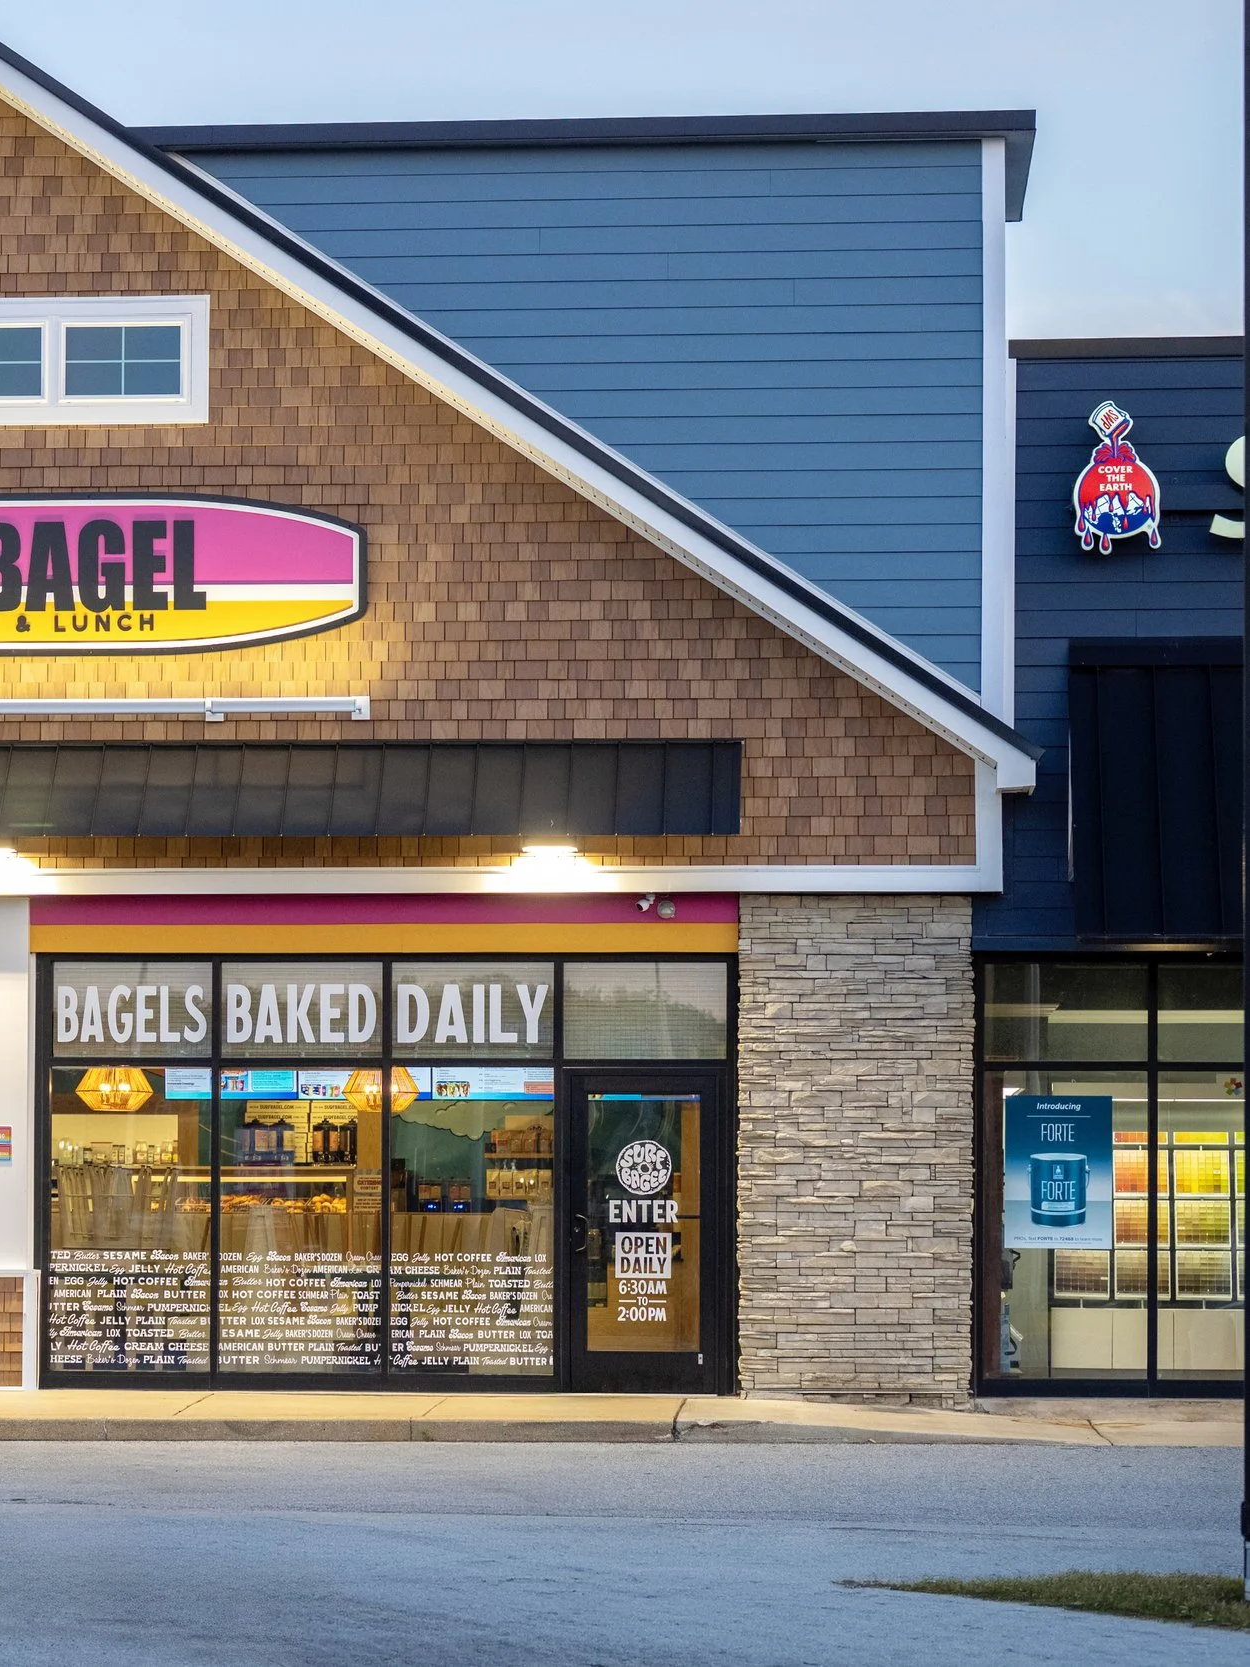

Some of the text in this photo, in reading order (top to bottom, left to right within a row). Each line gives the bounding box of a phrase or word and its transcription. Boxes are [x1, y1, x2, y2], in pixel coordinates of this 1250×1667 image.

[1101, 410, 1119, 430] SWP
[1100, 483, 1132, 491] EARTH
[15, 614, 31, 633] &
[54, 612, 156, 634] LUNCH
[57, 983, 548, 1043] BAGELS BAKED DAILY
[1037, 1103, 1081, 1111] Introducing
[1041, 1123, 1075, 1141] FORTE
[620, 1144, 666, 1169] SURF
[621, 1168, 667, 1191] BAGEL
[1041, 1181, 1076, 1200] FORTE
[609, 1200, 678, 1223] ENTER
[621, 1236, 667, 1255] OPEN
[103, 1252, 147, 1260] SESAME
[294, 1253, 342, 1261] BAKER'S DOZEN
[391, 1253, 546, 1262] EGG HOT COFFEE LOX
[129, 1265, 160, 1273] JELLY
[221, 1265, 259, 1273] AMERICAN
[620, 1257, 667, 1274] DAILY
[405, 1267, 521, 1275] CHEESE PLAIN
[64, 1277, 178, 1285] EGG HOT COFFEE
[289, 1278, 325, 1287] COFFEE
[431, 1279, 530, 1288] SCHMEAR TOASTED
[619, 1280, 667, 1295] 6:30AM
[54, 1290, 206, 1299] AMERICAN PLAIN BUTTER
[232, 1290, 328, 1299] HOT COFFEE SCHMEAR
[421, 1291, 537, 1300] SESAME BAKER'S DOZEN
[637, 1297, 648, 1305] TO
[443, 1305, 470, 1313] JELLY
[617, 1307, 666, 1322] 2:00PM
[100, 1317, 131, 1325] JELLY
[136, 1317, 165, 1325] PLAIN
[251, 1317, 362, 1325] LOX SESAME BAKER'S
[390, 1317, 490, 1325] EGG HOT COFFEE
[106, 1329, 174, 1337] LOX TOASTED
[313, 1330, 333, 1338] DOZEN
[419, 1330, 531, 1339] PLAIN BUTTER LOX
[124, 1342, 164, 1350] CREAM
[219, 1343, 264, 1351] AMERICAN
[267, 1343, 304, 1351] BUTTER
[463, 1344, 533, 1352] PUMPERNICKEL
[143, 1356, 174, 1364] PLAIN
[301, 1356, 370, 1365] PUMPERNICKEL
[422, 1357, 547, 1365] JELLY PLAIN BUTTER
